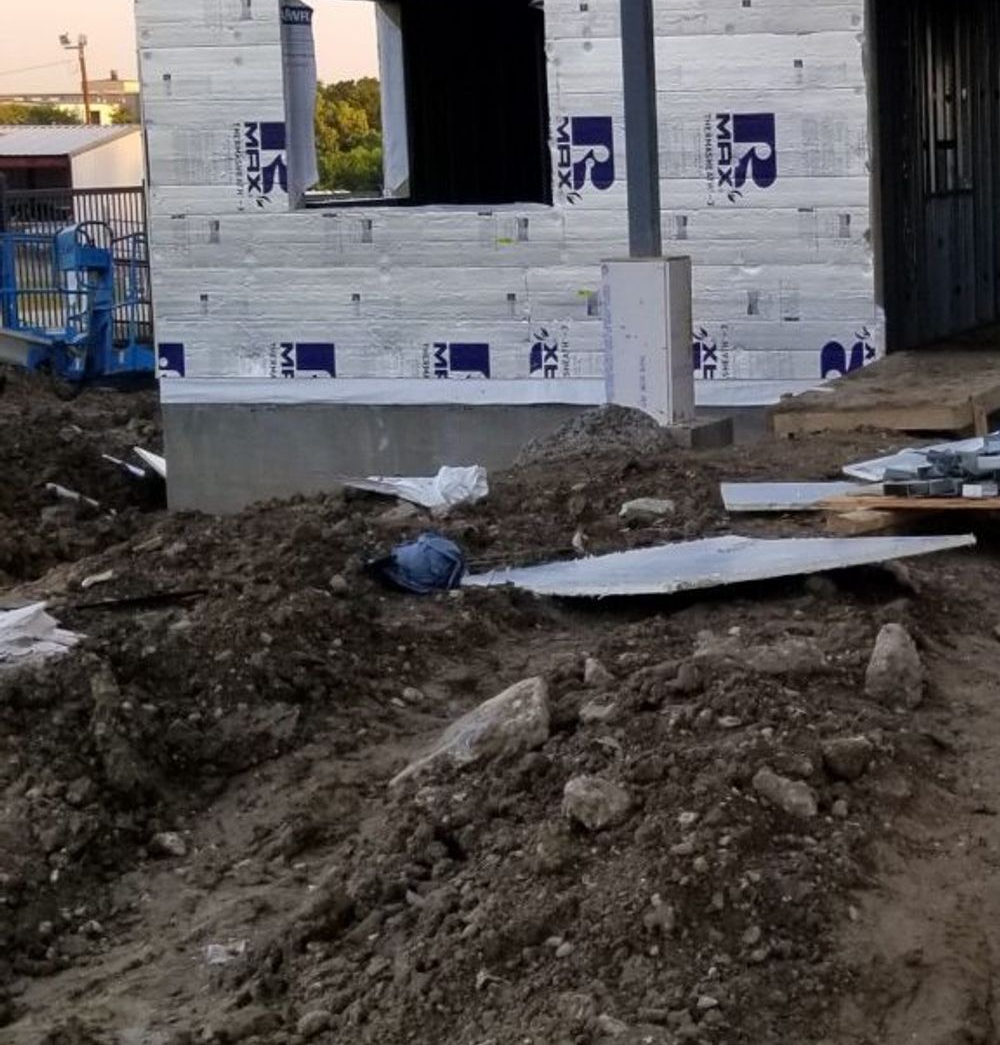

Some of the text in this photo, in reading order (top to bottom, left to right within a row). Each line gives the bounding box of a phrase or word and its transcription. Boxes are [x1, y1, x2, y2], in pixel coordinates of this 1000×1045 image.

[244, 121, 261, 193] MAX
[556, 116, 572, 189] MAX
[715, 113, 733, 187] MAX
